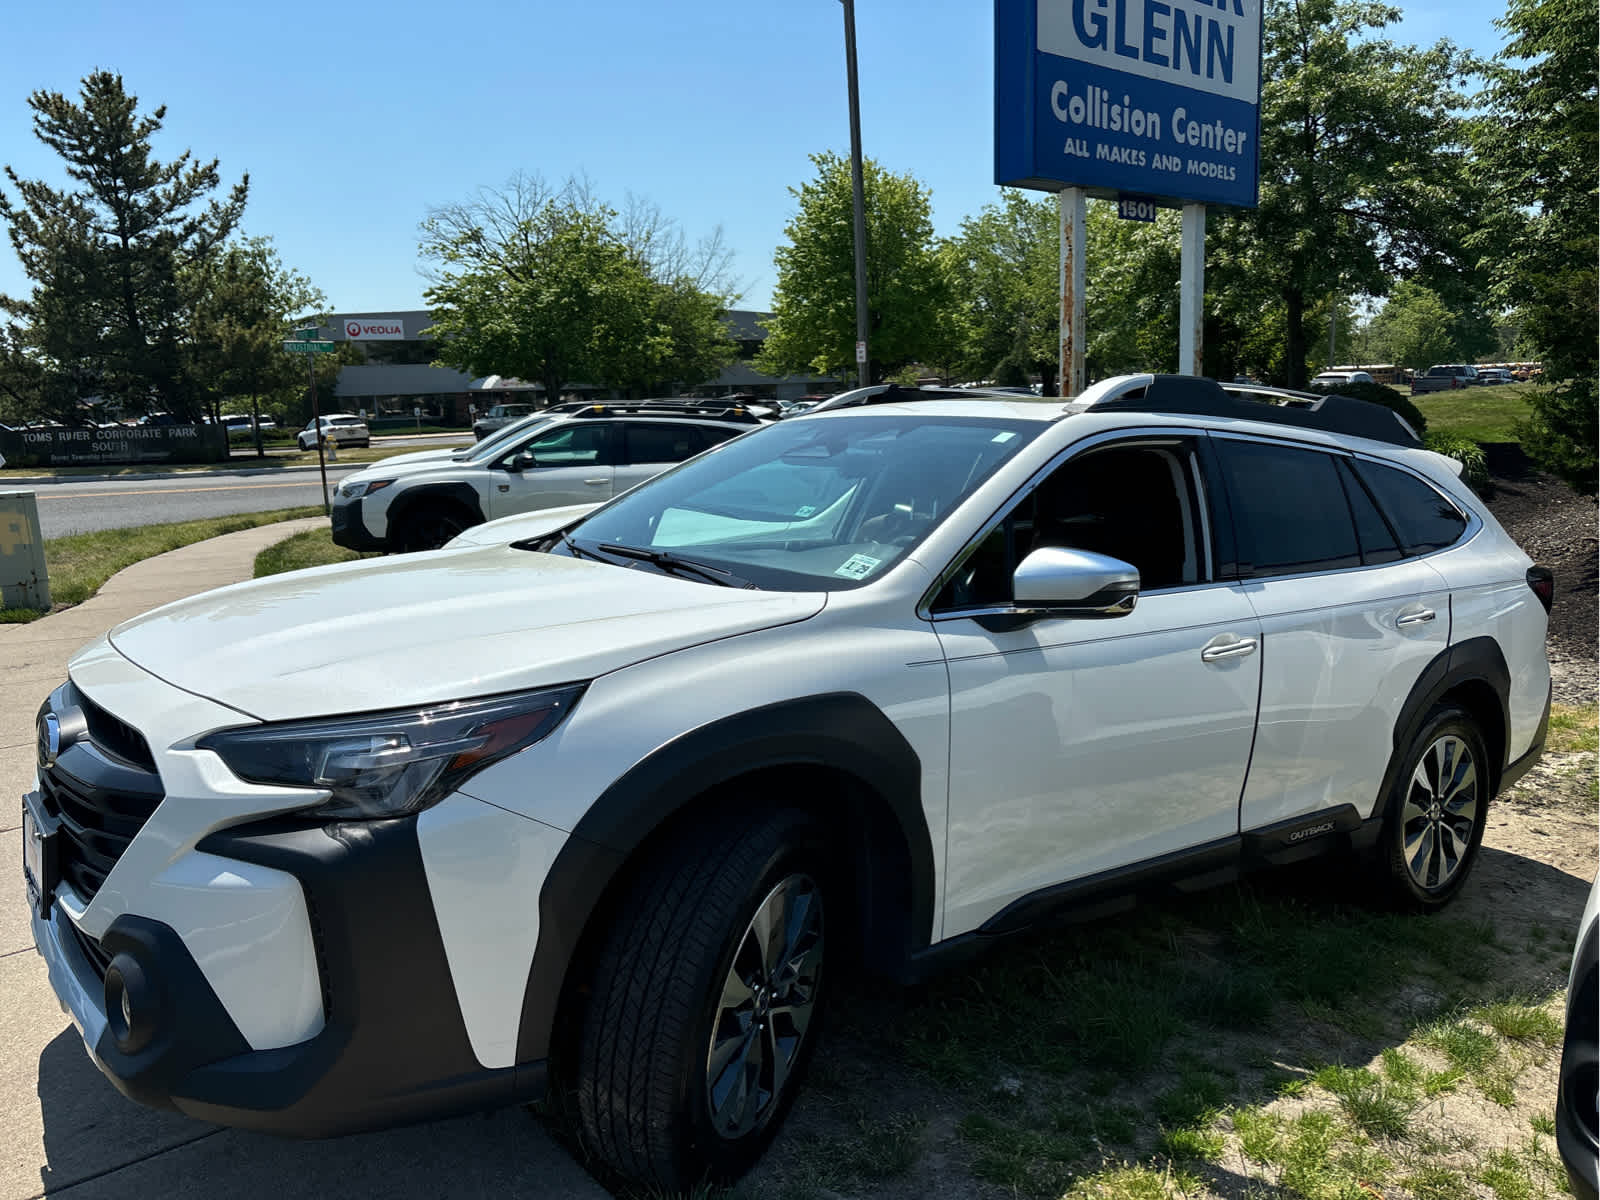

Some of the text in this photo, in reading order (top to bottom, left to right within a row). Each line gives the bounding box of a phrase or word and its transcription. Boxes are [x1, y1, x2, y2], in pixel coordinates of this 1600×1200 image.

[1072, 0, 1235, 85] GLENN
[1051, 80, 1247, 155] Collision Center
[1064, 137, 1236, 181] ALL MAKES AND MODELS
[1120, 201, 1155, 219] 1501
[363, 325, 401, 335] VEOLIA
[23, 427, 197, 443] TOMS RIVER CORPORATE PARK
[1290, 821, 1335, 841] OUTBACK
